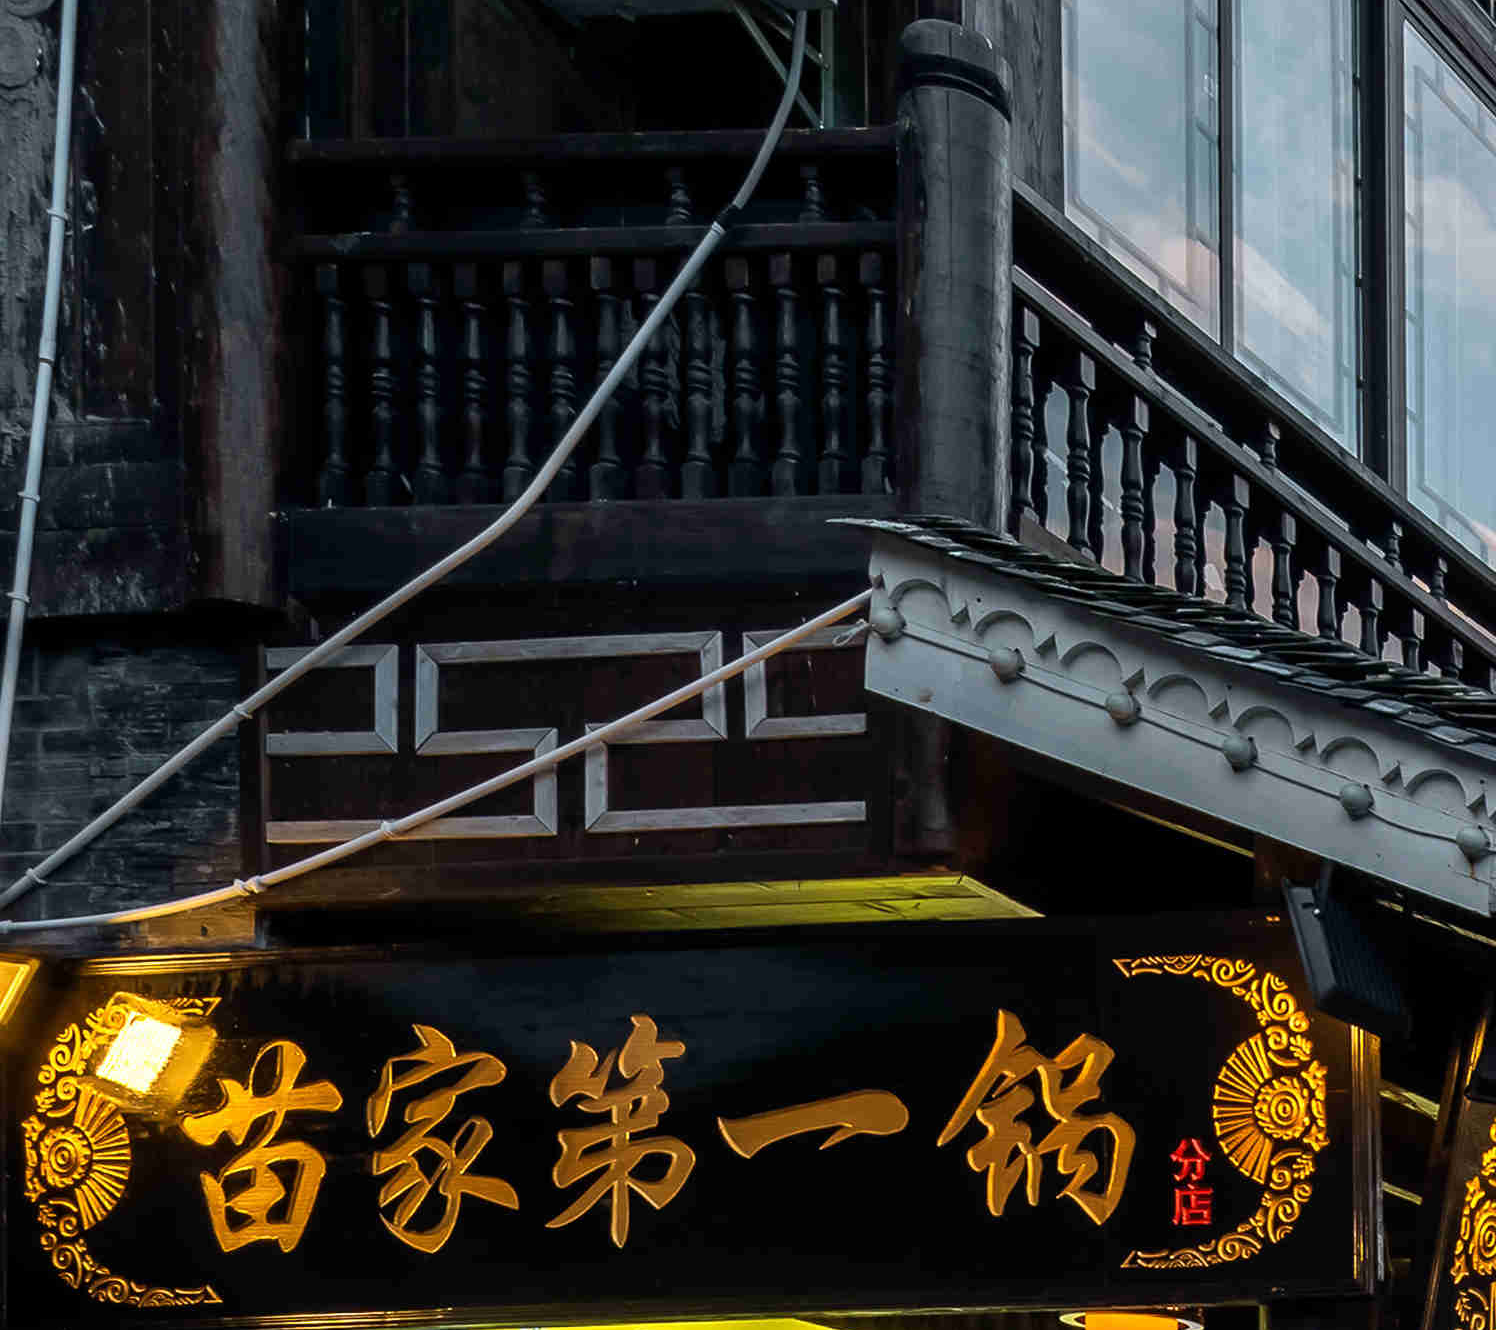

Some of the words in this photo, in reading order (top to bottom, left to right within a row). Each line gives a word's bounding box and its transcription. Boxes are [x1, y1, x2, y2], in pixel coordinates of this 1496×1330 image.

[180, 1008, 1136, 1254] 苗家第一锅
[1169, 1137, 1213, 1226] 分店
